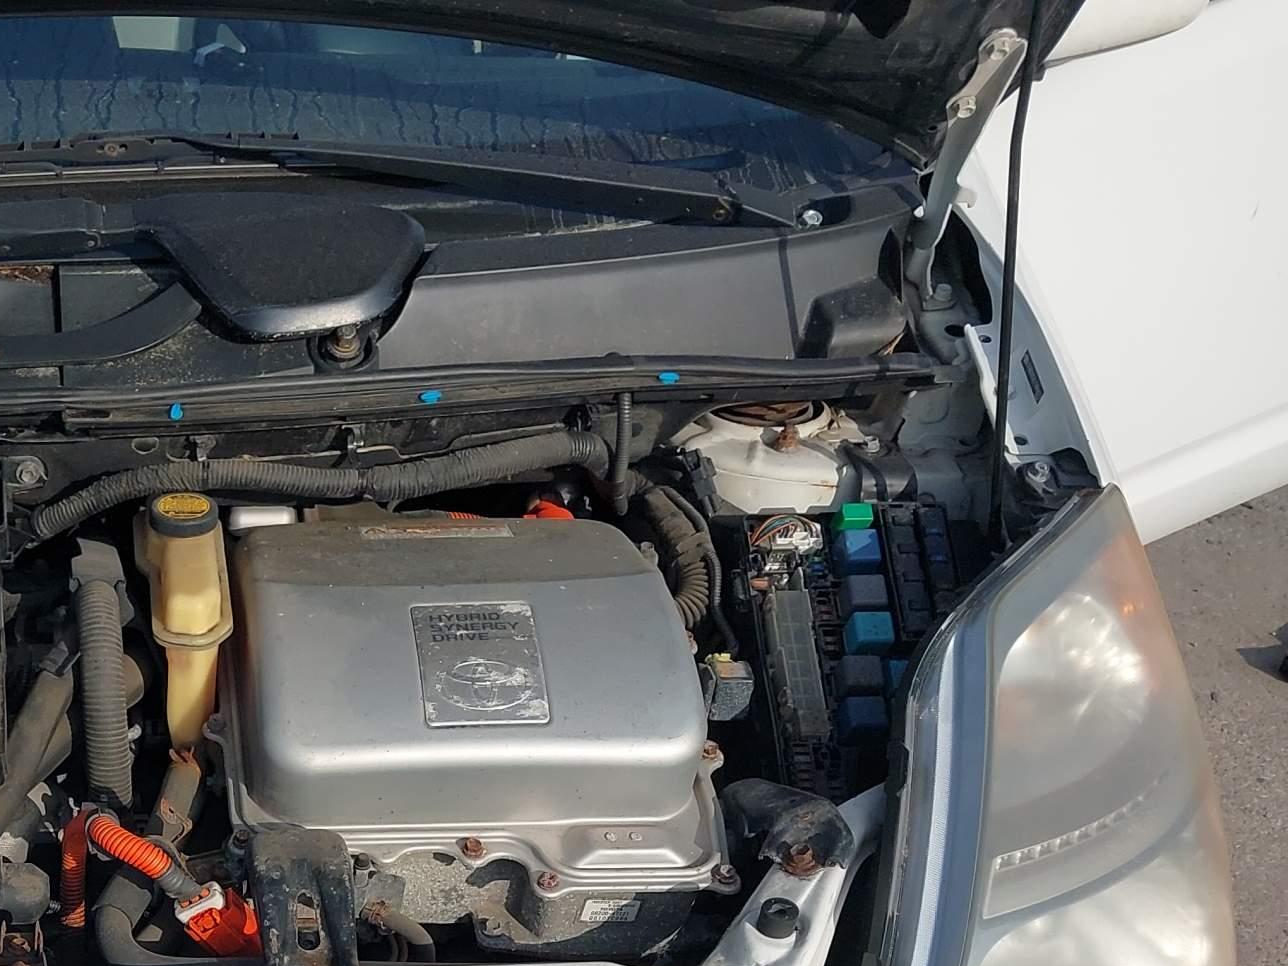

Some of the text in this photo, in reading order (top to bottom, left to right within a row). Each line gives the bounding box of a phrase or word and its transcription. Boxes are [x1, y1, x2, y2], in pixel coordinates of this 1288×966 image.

[428, 612, 501, 623] HYBRID
[429, 622, 519, 633] SYNERGY
[432, 632, 490, 643] DRIVE
